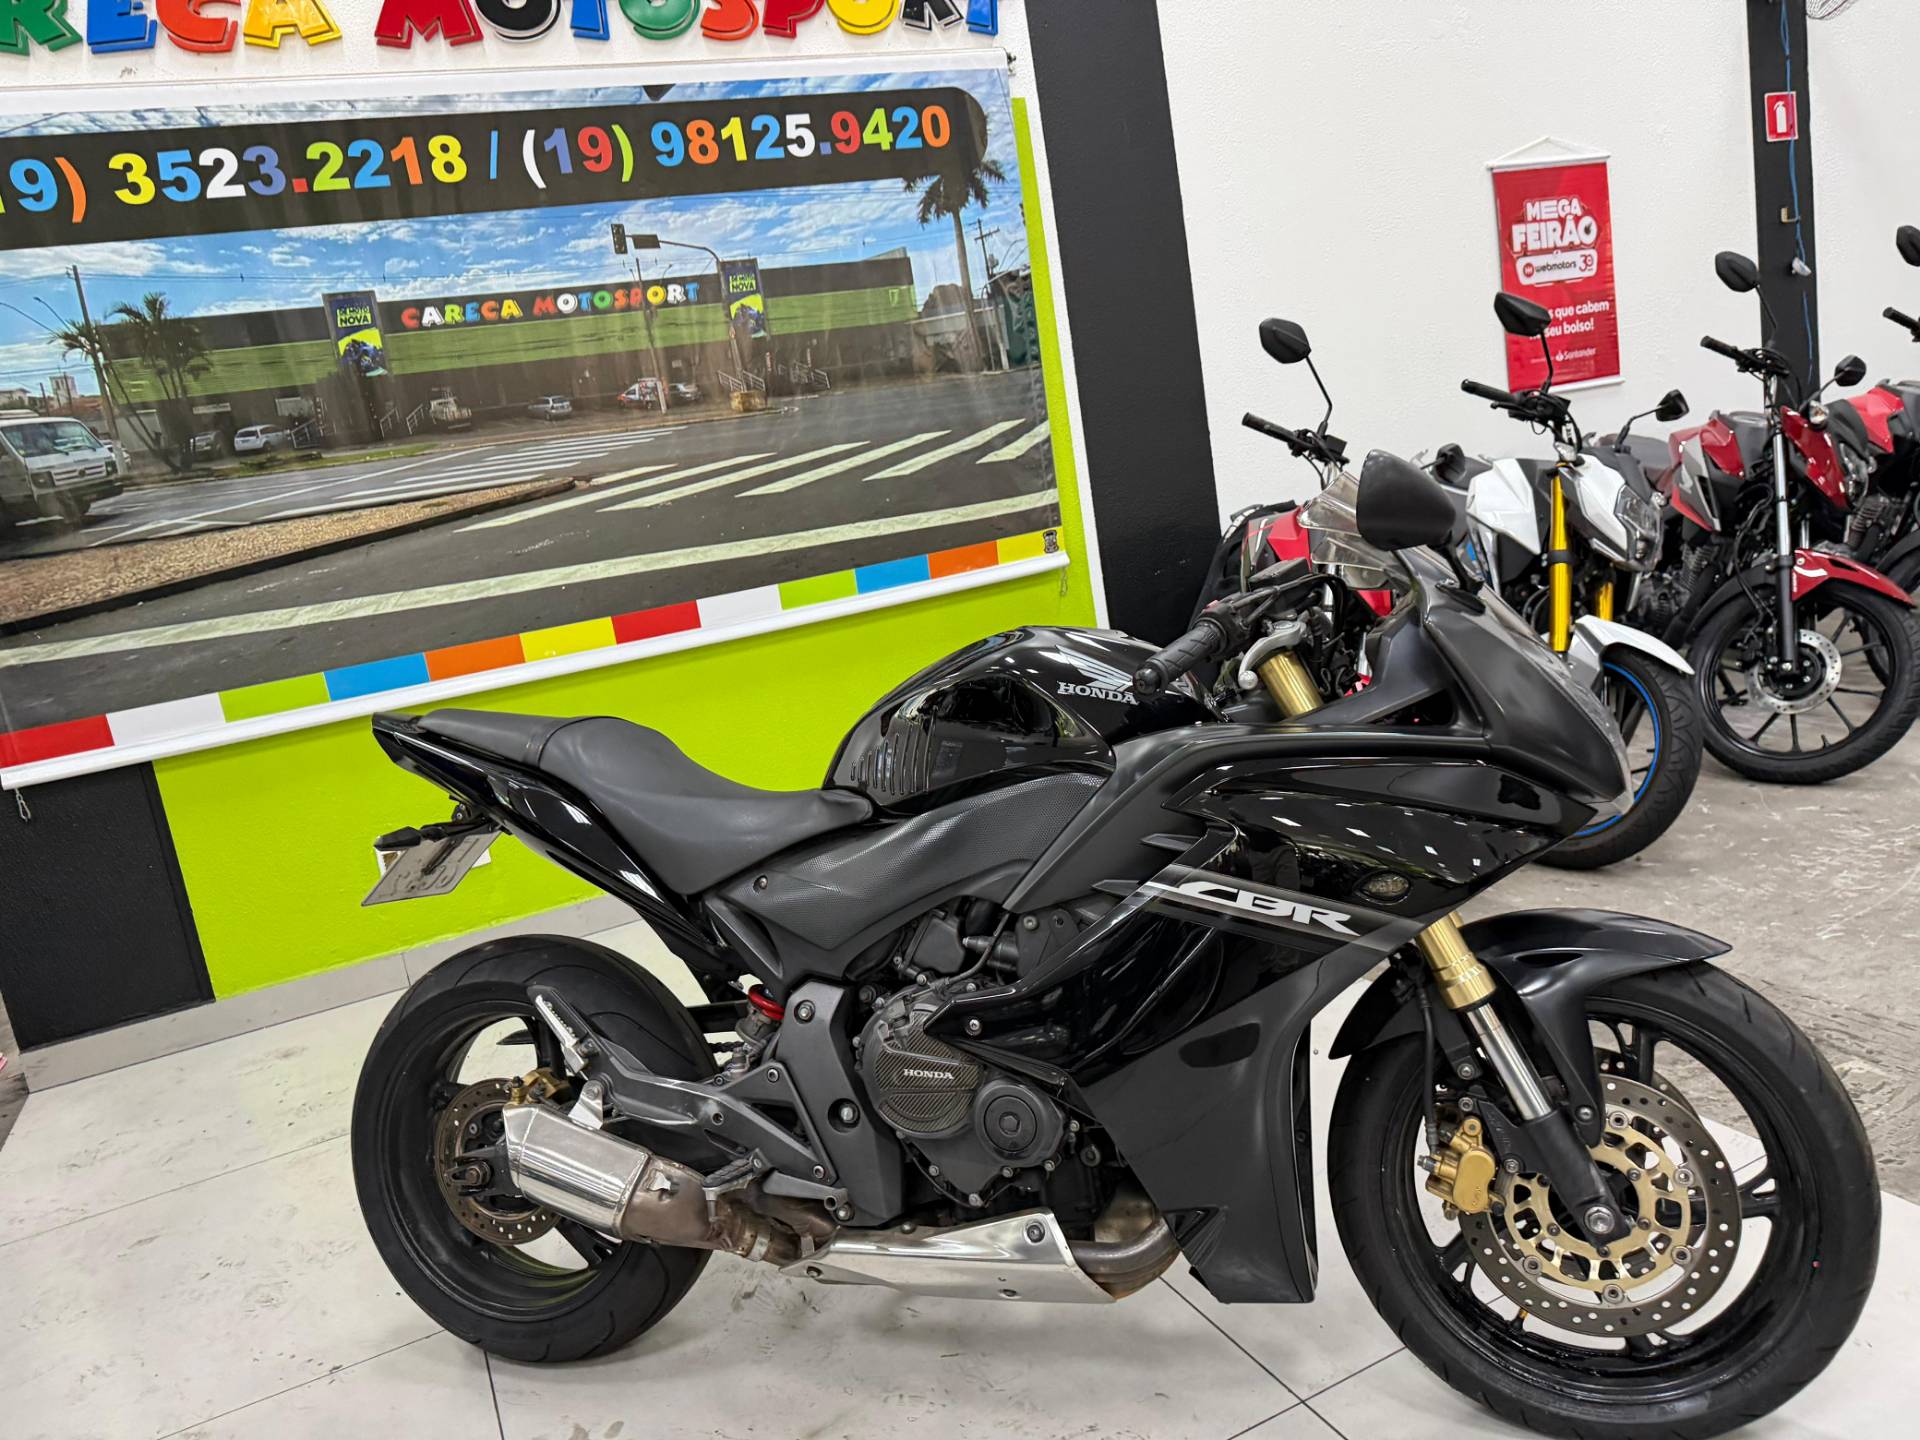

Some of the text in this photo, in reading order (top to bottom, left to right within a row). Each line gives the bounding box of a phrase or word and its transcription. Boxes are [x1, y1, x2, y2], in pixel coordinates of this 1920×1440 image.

[0, 155, 87, 224] 9)
[108, 134, 467, 205] 3523.2218
[522, 125, 634, 189] (19)
[651, 105, 950, 167] 98125.9420
[1526, 198, 1582, 221] MEGA
[1512, 214, 1597, 252] FEIRÃO
[1535, 260, 1577, 273] webmotors
[401, 282, 699, 329] CARECA MOTOSPORT
[1554, 306, 1574, 320] que
[1575, 300, 1610, 315] cabem
[340, 315, 370, 326] NOVA
[1543, 317, 1594, 338] seu bolso!
[1564, 347, 1597, 360] Santander
[1057, 680, 1139, 706] HONDA
[1165, 880, 1361, 937] CBR
[903, 1068, 954, 1080] HONDA
